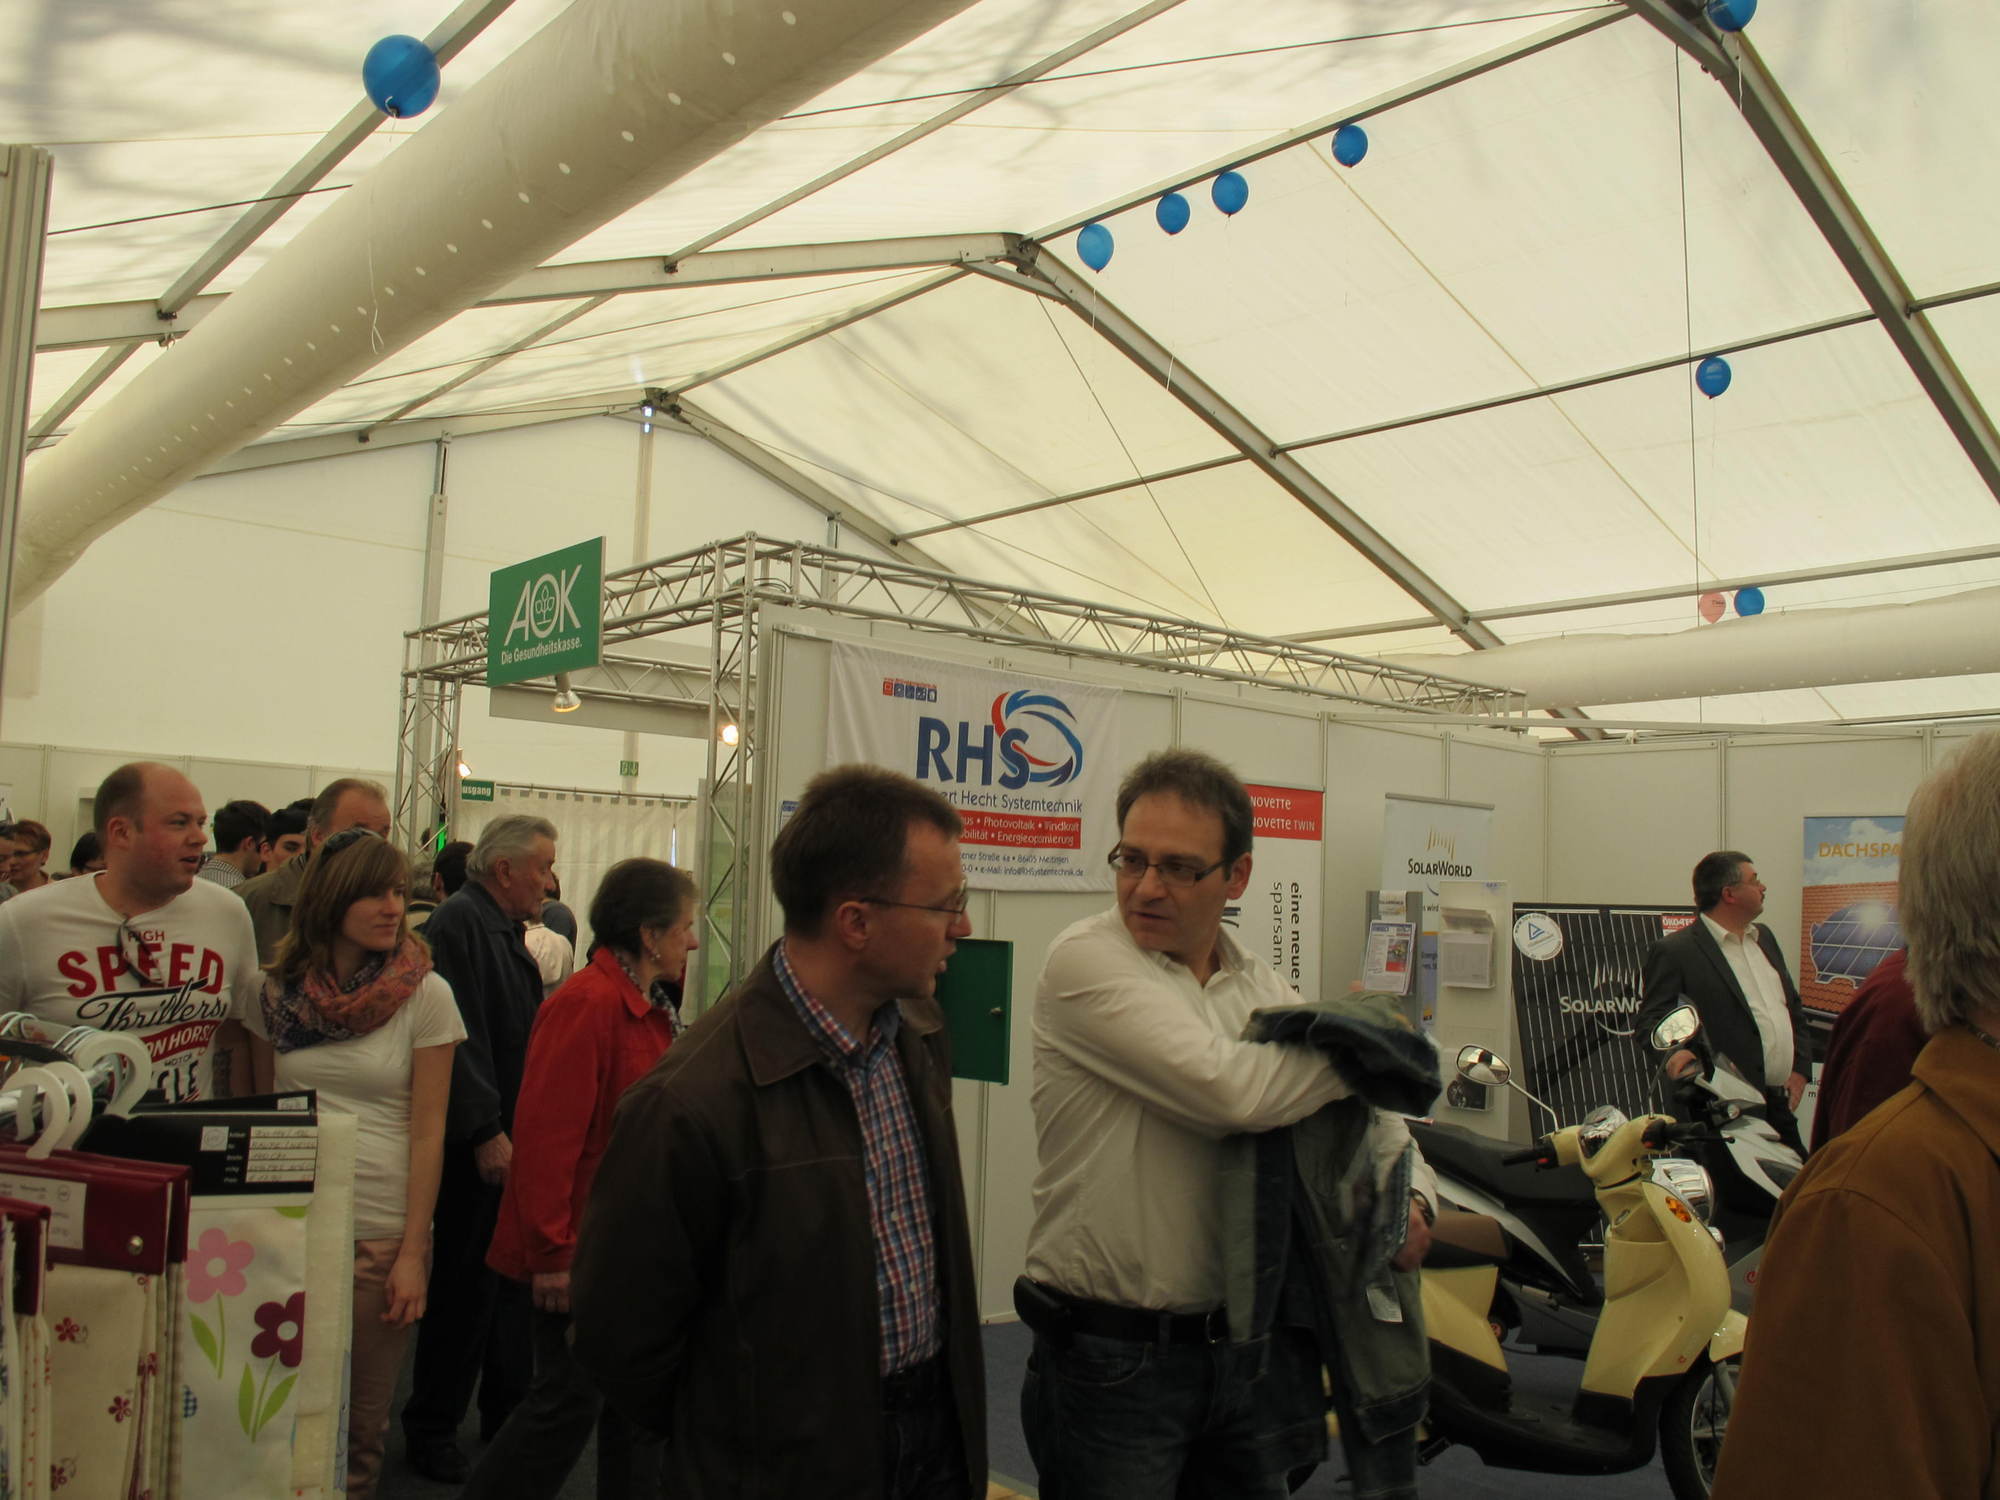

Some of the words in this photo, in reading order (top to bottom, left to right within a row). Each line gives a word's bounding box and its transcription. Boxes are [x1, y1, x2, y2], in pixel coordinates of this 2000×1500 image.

[504, 563, 582, 647] AOK
[501, 651, 513, 665] Die
[513, 637, 583, 662] Gesundheitskasse.
[916, 716, 1030, 790] RHS
[462, 785, 492, 797] usgang
[961, 791, 997, 808] Hecht
[1001, 794, 1083, 813] Systemtechnik
[983, 816, 1036, 830] Photovoltaik
[1290, 882, 1302, 925] eine
[57, 943, 225, 998] SPEED
[1290, 930, 1301, 979] neue
